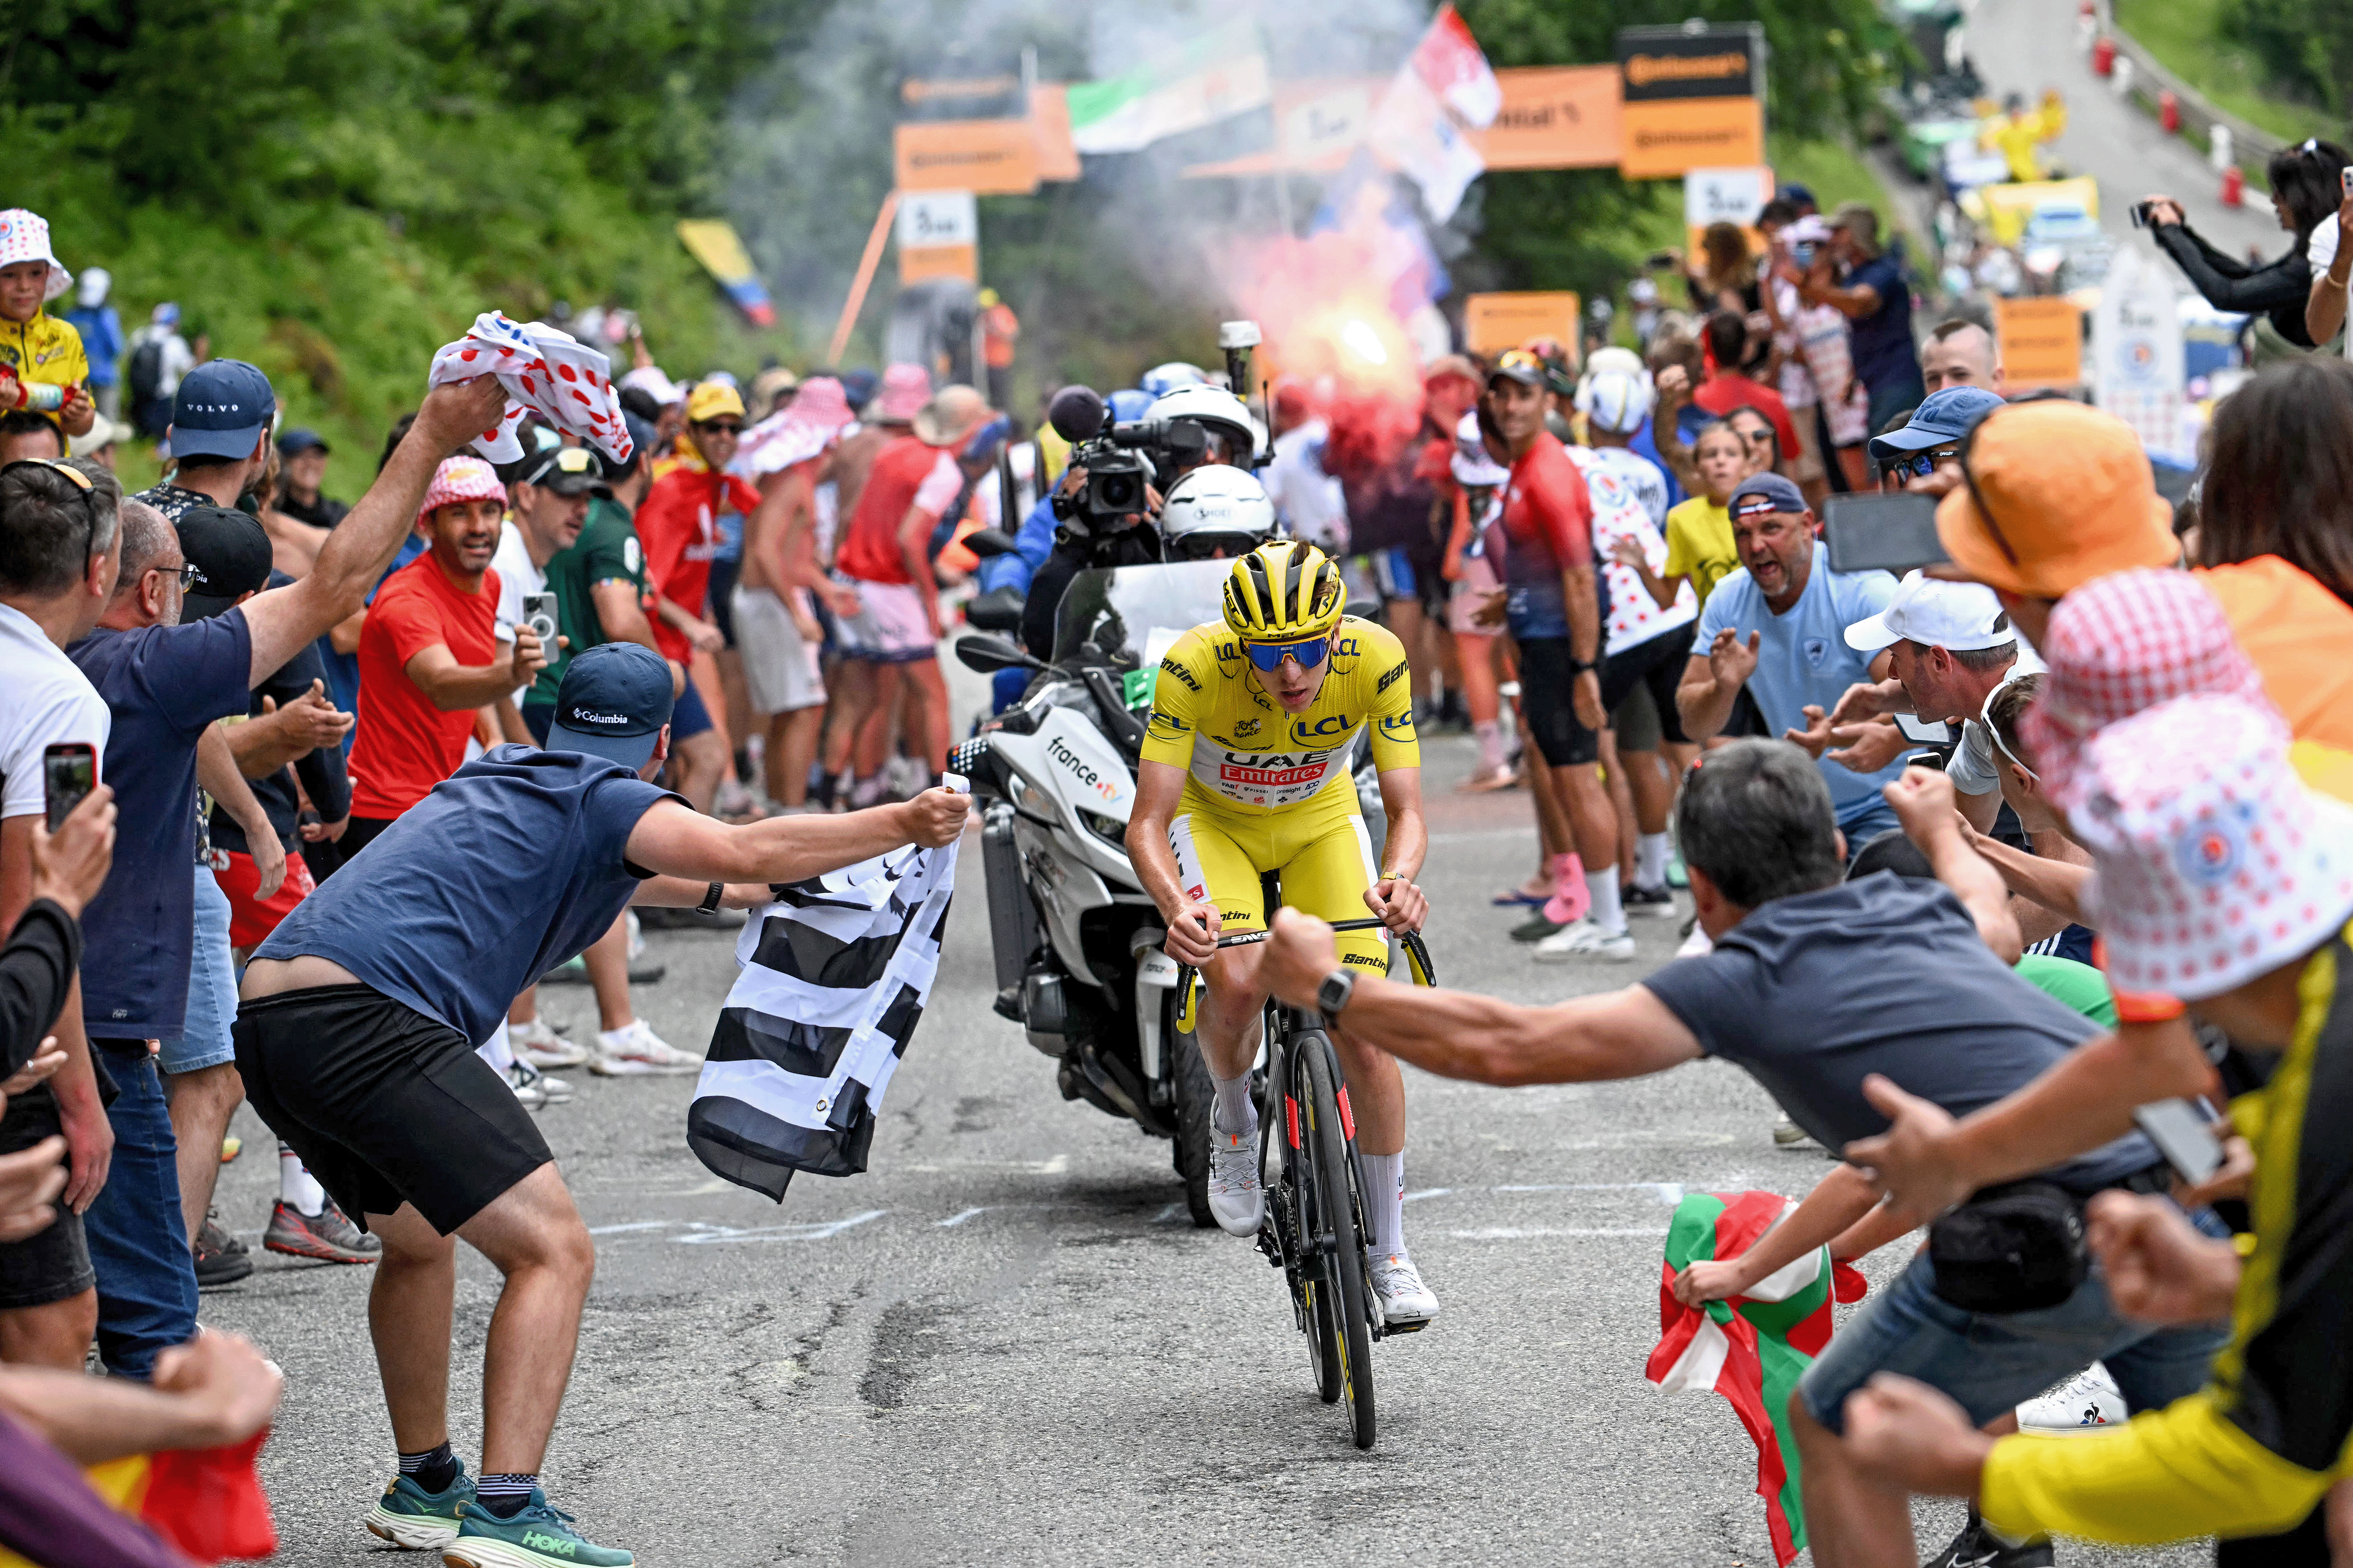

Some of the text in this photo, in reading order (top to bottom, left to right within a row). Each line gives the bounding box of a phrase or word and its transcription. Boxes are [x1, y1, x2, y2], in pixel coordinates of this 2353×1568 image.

[187, 404, 238, 412] VOLVO
[1223, 581, 1240, 615] MET
[1314, 621, 1328, 629] presight
[1160, 658, 1202, 692] antini
[1253, 694, 1272, 711] LCL
[582, 711, 627, 724] Columbia
[1298, 715, 1358, 737] LCL
[1385, 710, 1412, 728] LC
[1224, 750, 1334, 768] UAE
[1224, 765, 1323, 782] Emirates
[1276, 786, 1300, 794] presight
[1220, 911, 1251, 921] ntini
[522, 1530, 576, 1557] HOKA
